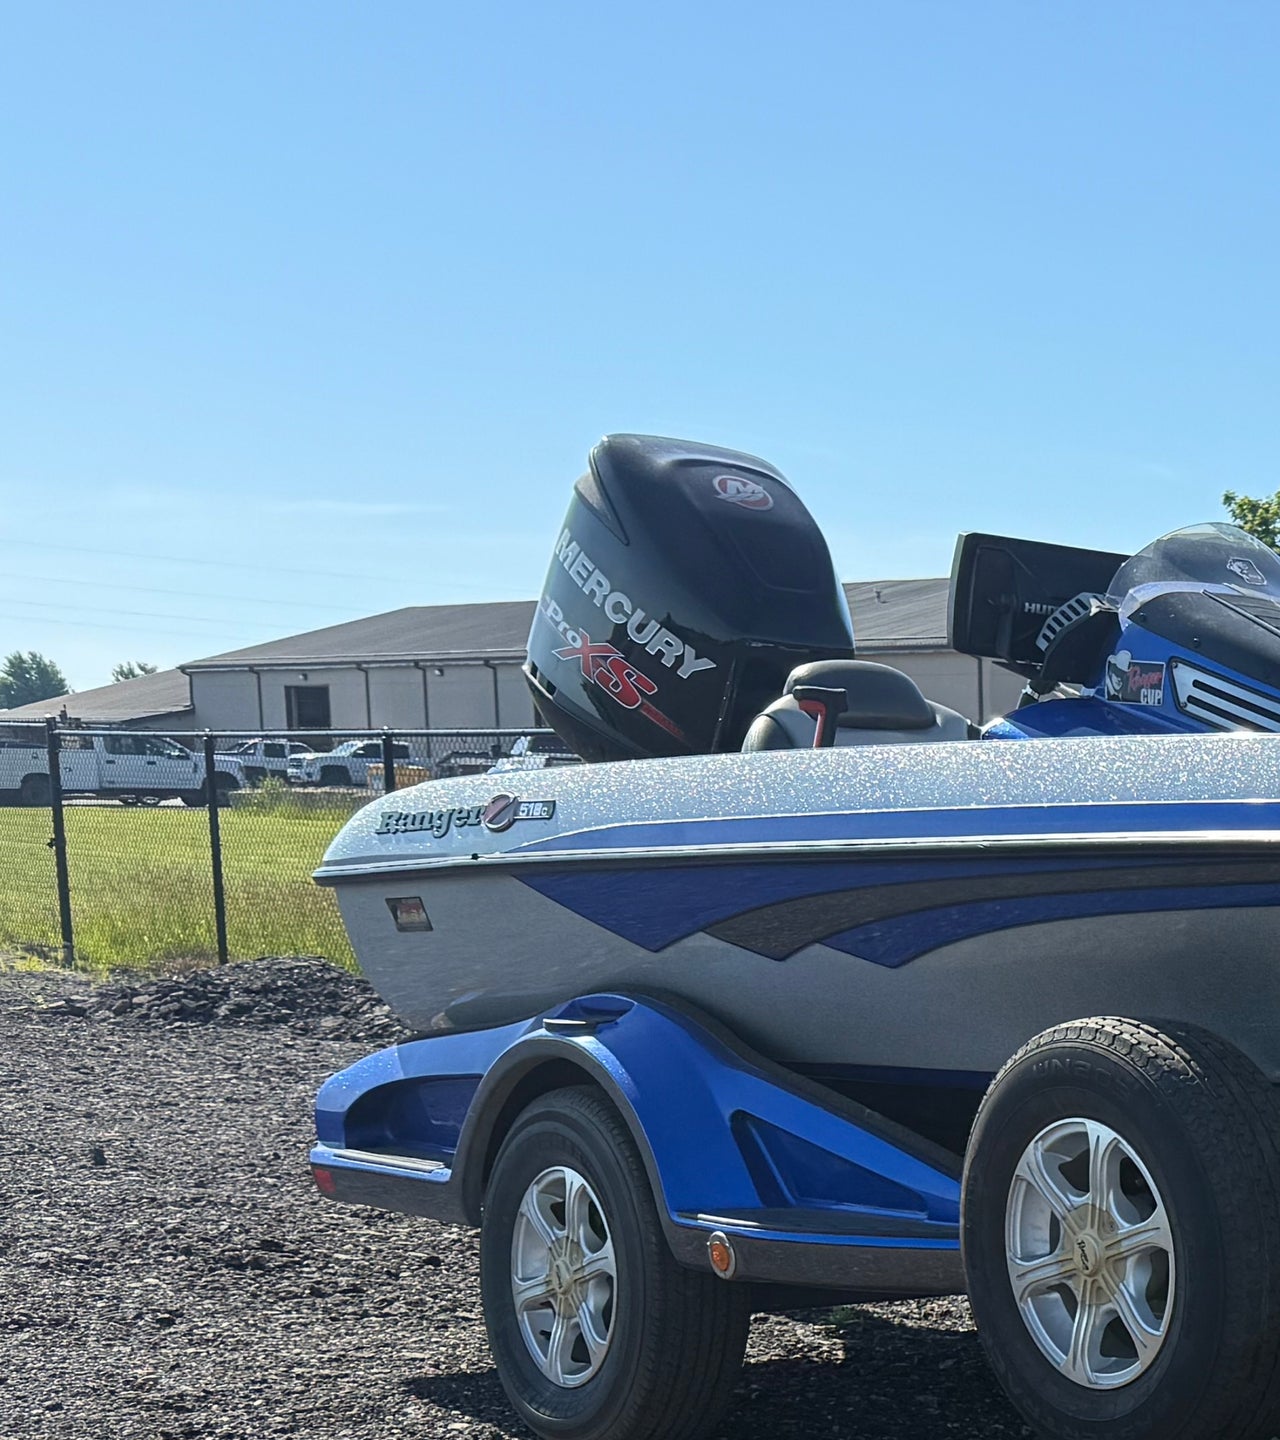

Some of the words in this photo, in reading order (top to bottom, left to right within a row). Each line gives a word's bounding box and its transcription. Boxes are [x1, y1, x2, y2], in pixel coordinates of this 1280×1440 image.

[556, 528, 717, 679] MERCURY
[1140, 688, 1163, 705] CUP
[375, 804, 486, 839] Ranger
